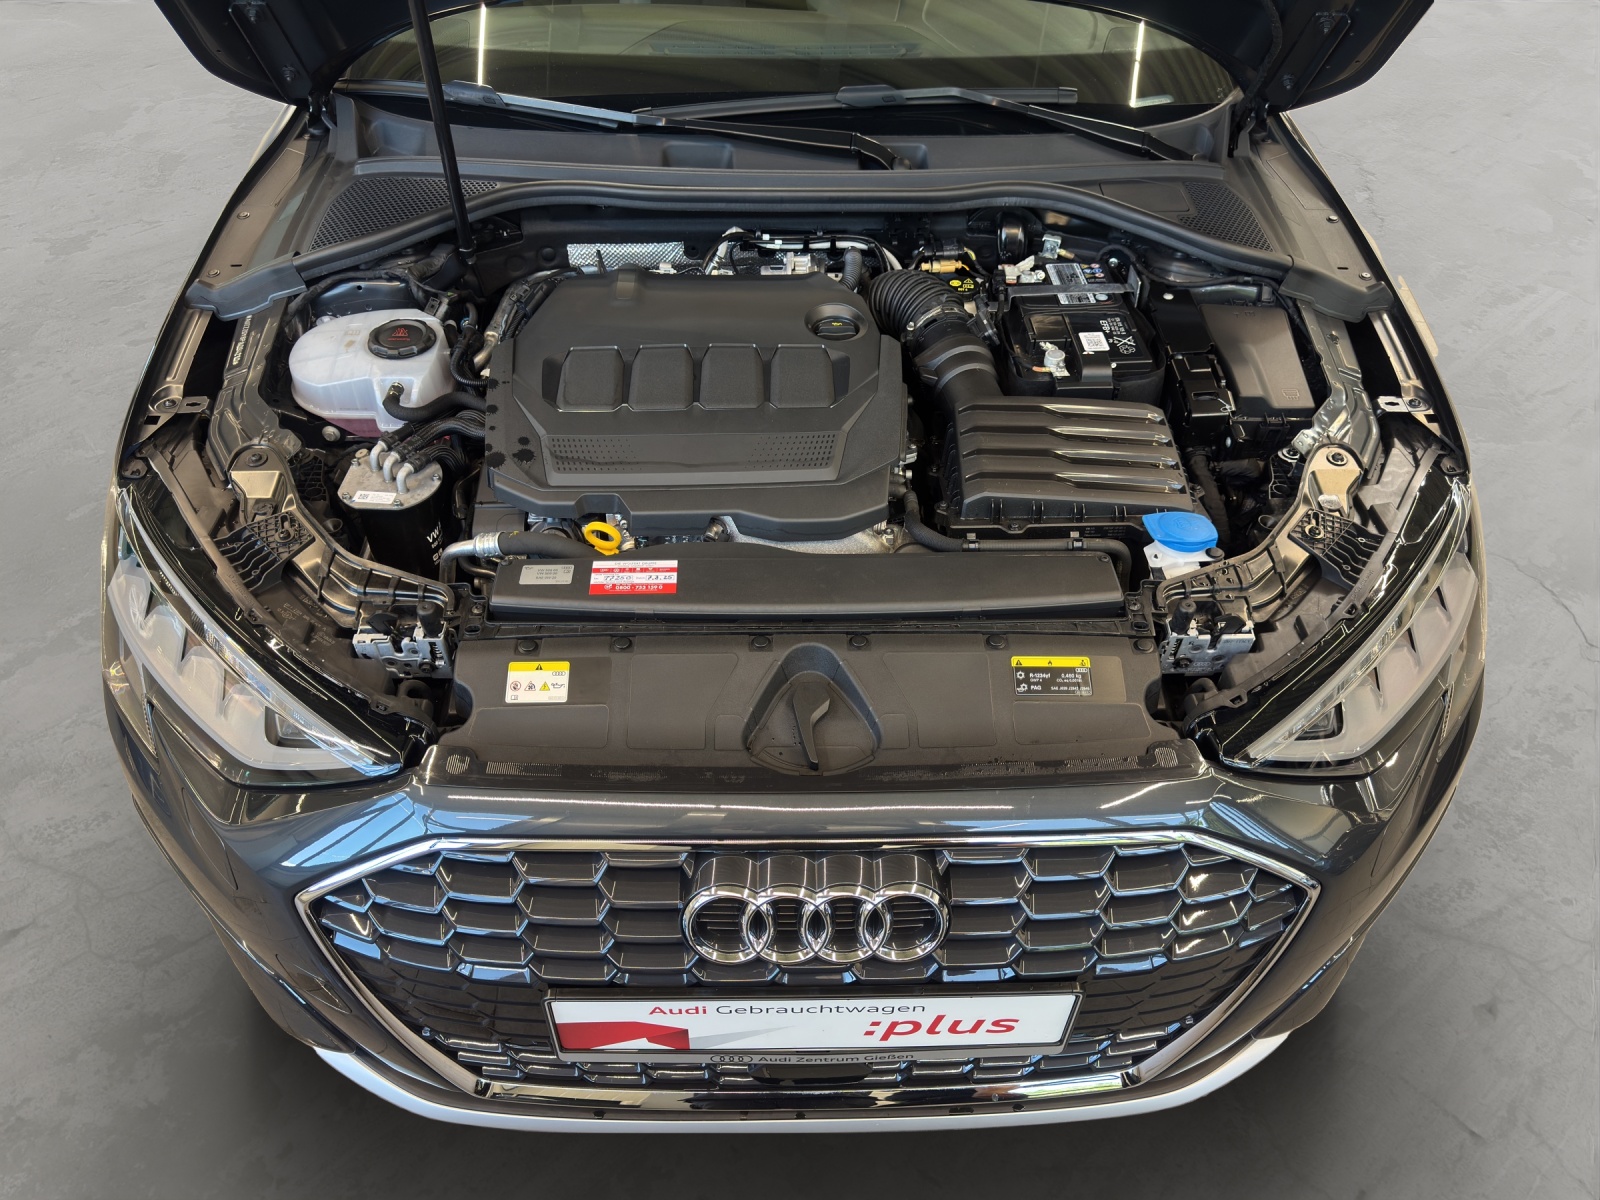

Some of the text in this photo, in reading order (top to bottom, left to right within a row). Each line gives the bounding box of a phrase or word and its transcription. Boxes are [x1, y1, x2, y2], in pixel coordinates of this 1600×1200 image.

[649, 1004, 926, 1015] Audi Gebrauchtwagen
[863, 1014, 1020, 1042] :plus
[864, 1053, 914, 1061] Gießen
